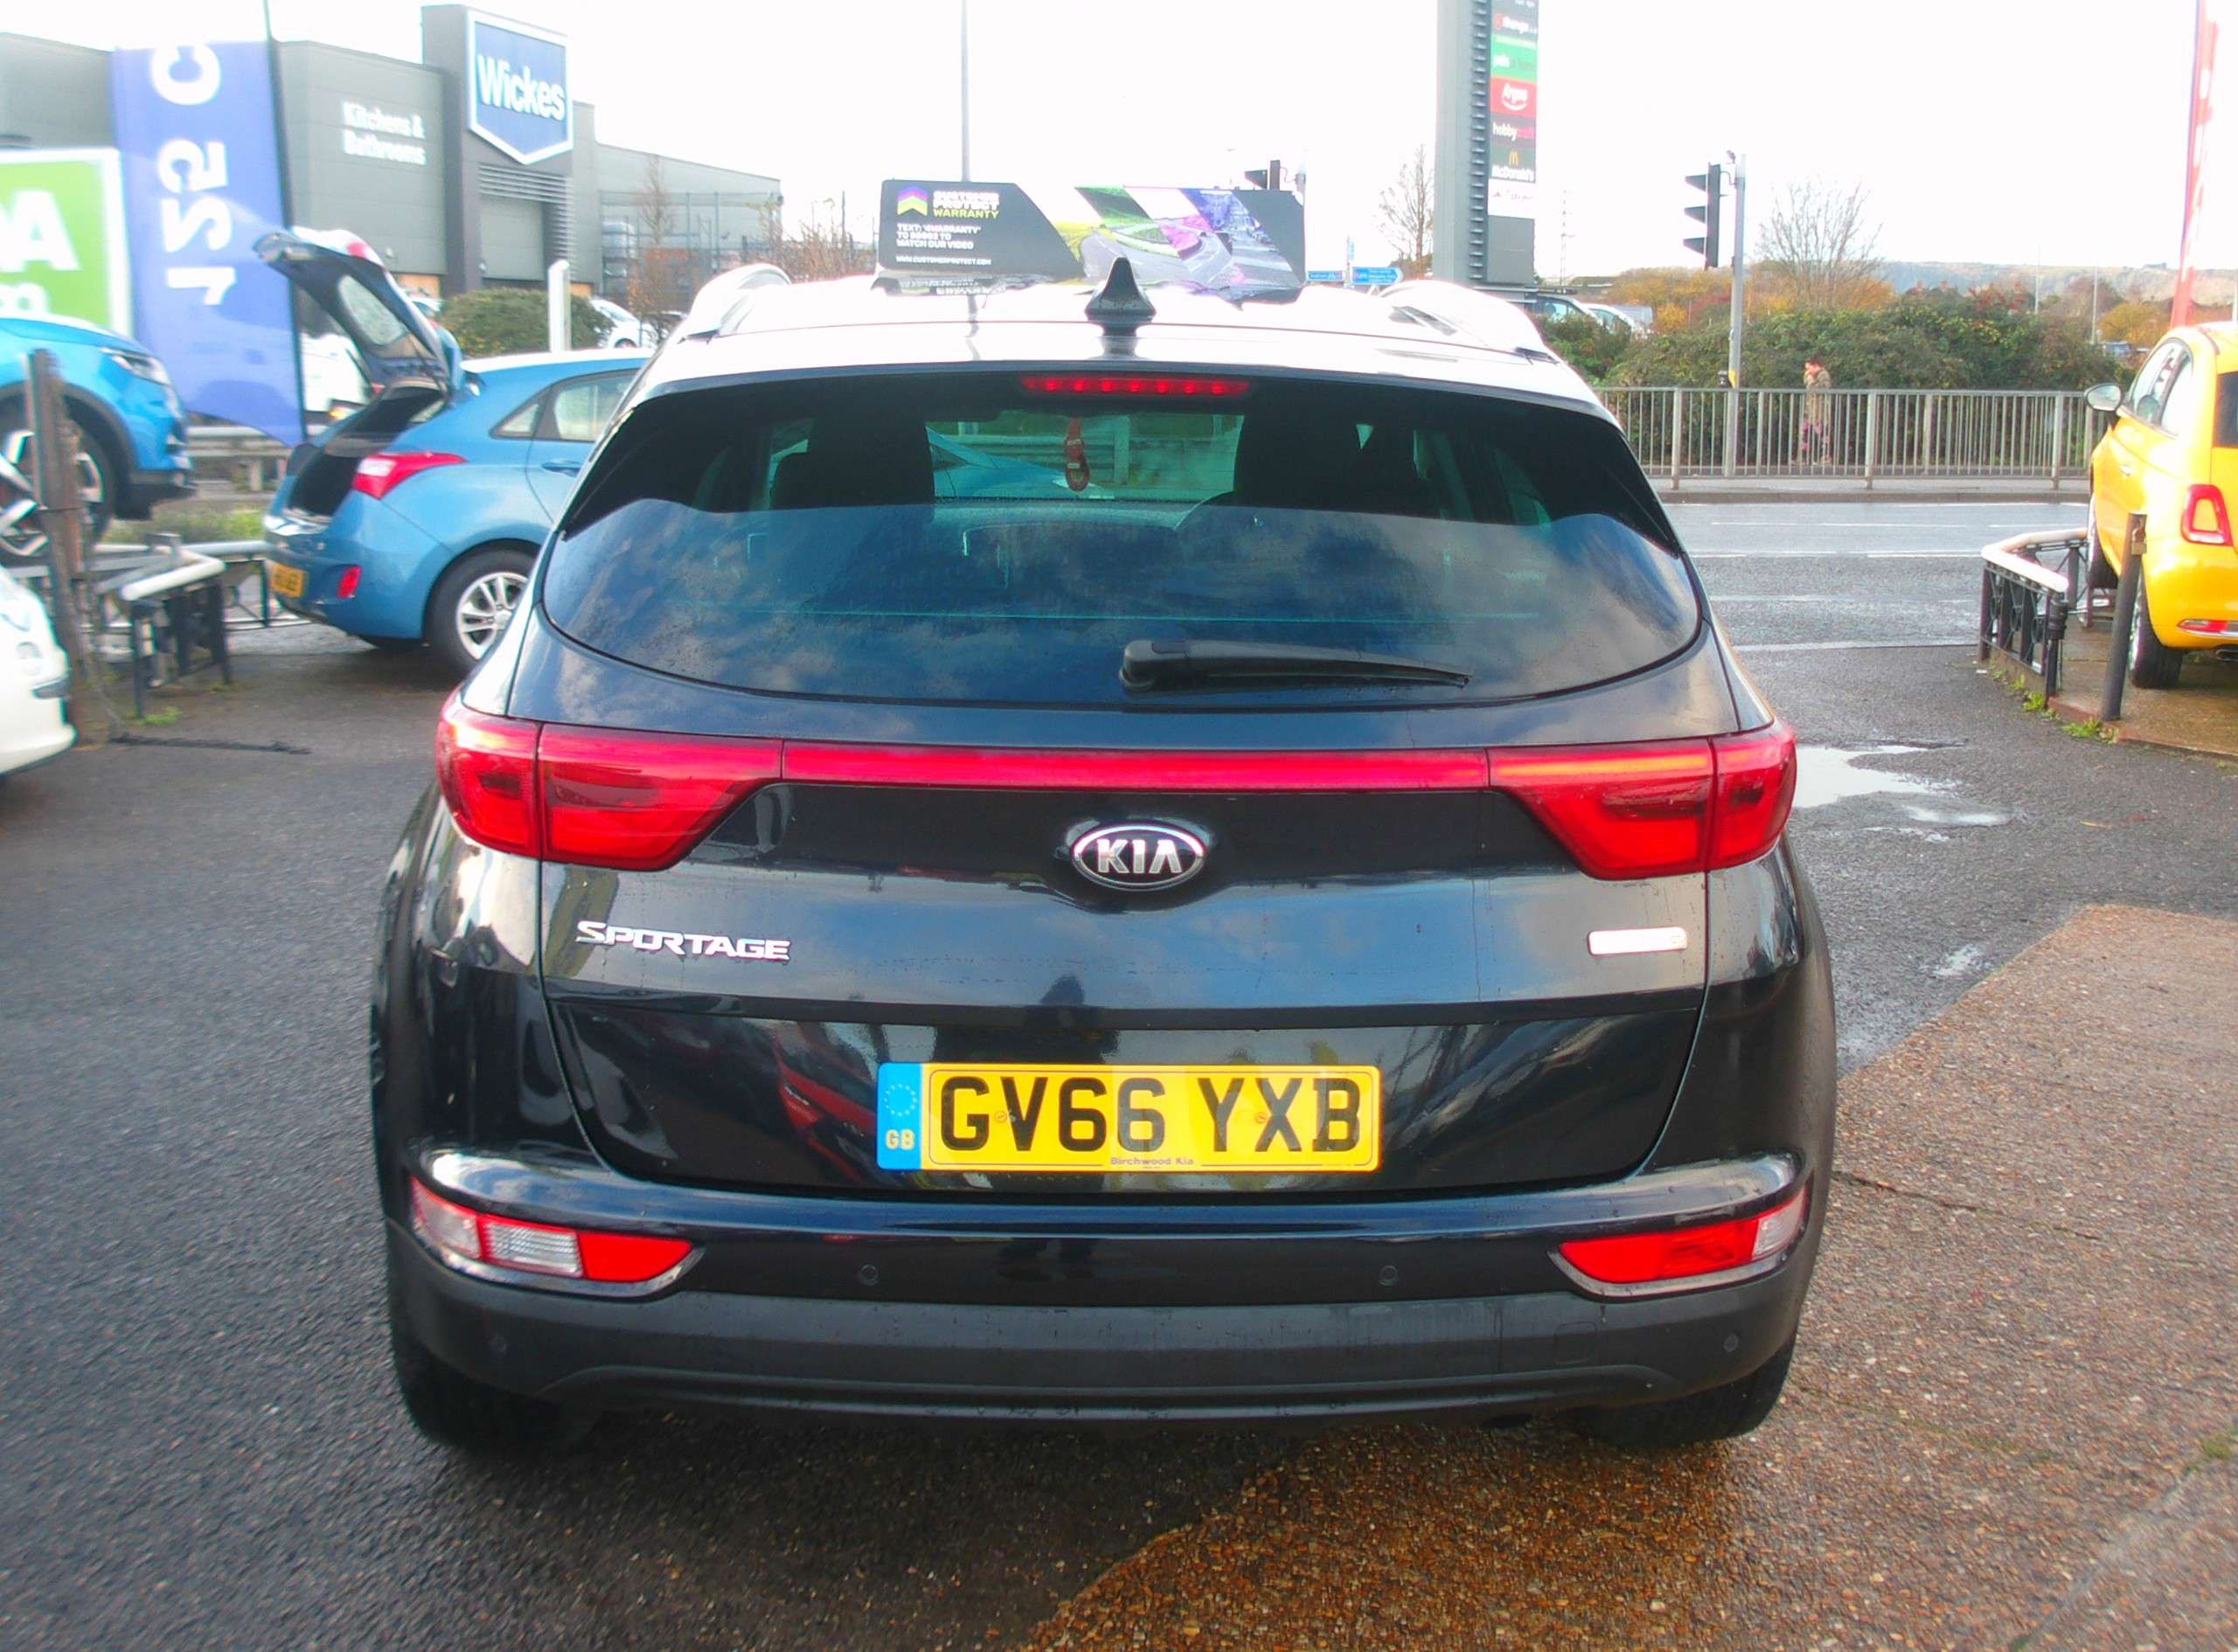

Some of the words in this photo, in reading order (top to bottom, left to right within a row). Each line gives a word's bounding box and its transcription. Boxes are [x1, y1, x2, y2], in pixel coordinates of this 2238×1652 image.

[477, 54, 566, 121] Wickes
[934, 209, 998, 219] WARRANTY
[896, 239, 927, 247] WATCH
[928, 239, 946, 248] OUR
[948, 240, 974, 250] VIDEO
[1095, 838, 1183, 874] KIA
[574, 920, 790, 960] SPORTAGE
[940, 1075, 1165, 1152] GV66
[1198, 1076, 1362, 1152] YXB
[886, 1129, 915, 1150] GB
[1110, 1156, 1171, 1165] Birchwood
